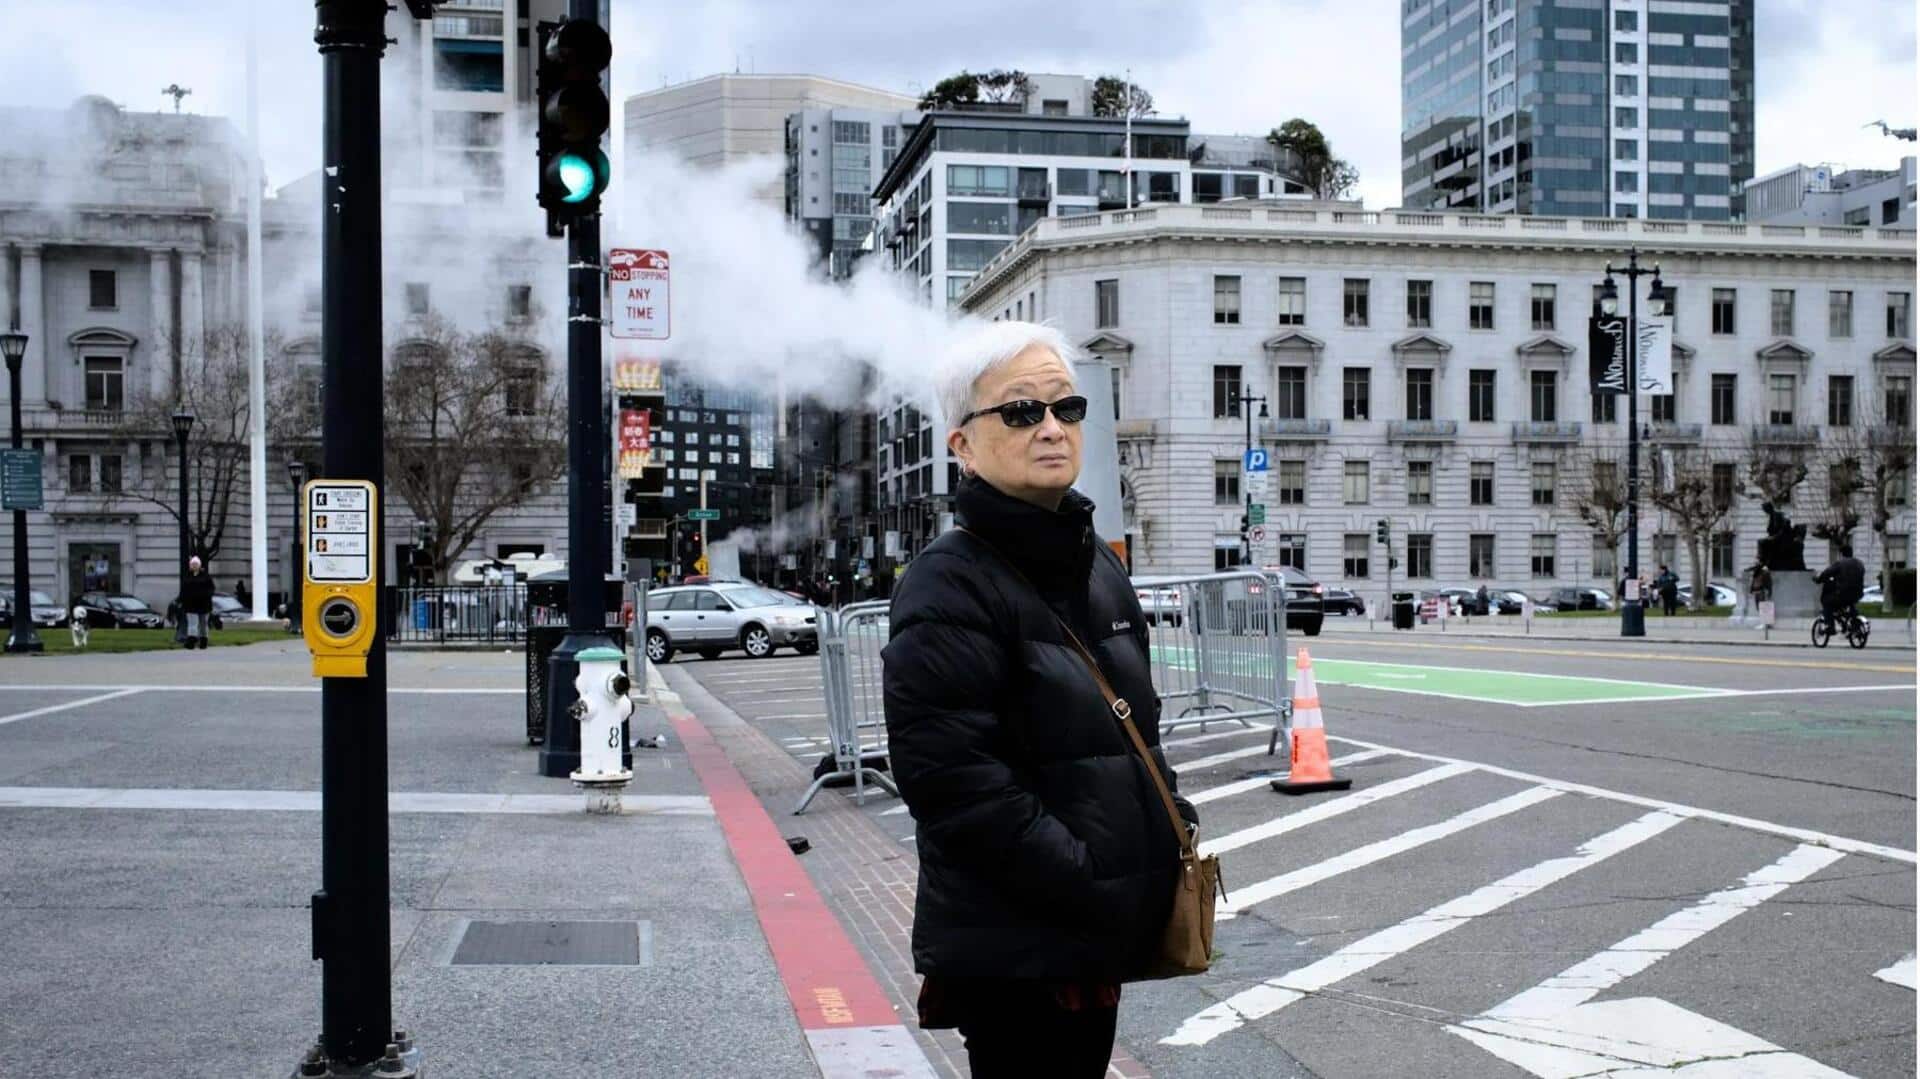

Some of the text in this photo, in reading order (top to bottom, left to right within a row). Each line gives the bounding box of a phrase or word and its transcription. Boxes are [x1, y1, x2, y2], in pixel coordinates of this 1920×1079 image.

[612, 269, 667, 280] NO STOPPING
[629, 288, 650, 300] ANY
[626, 306, 654, 320] TIME
[609, 726, 619, 748] 8
